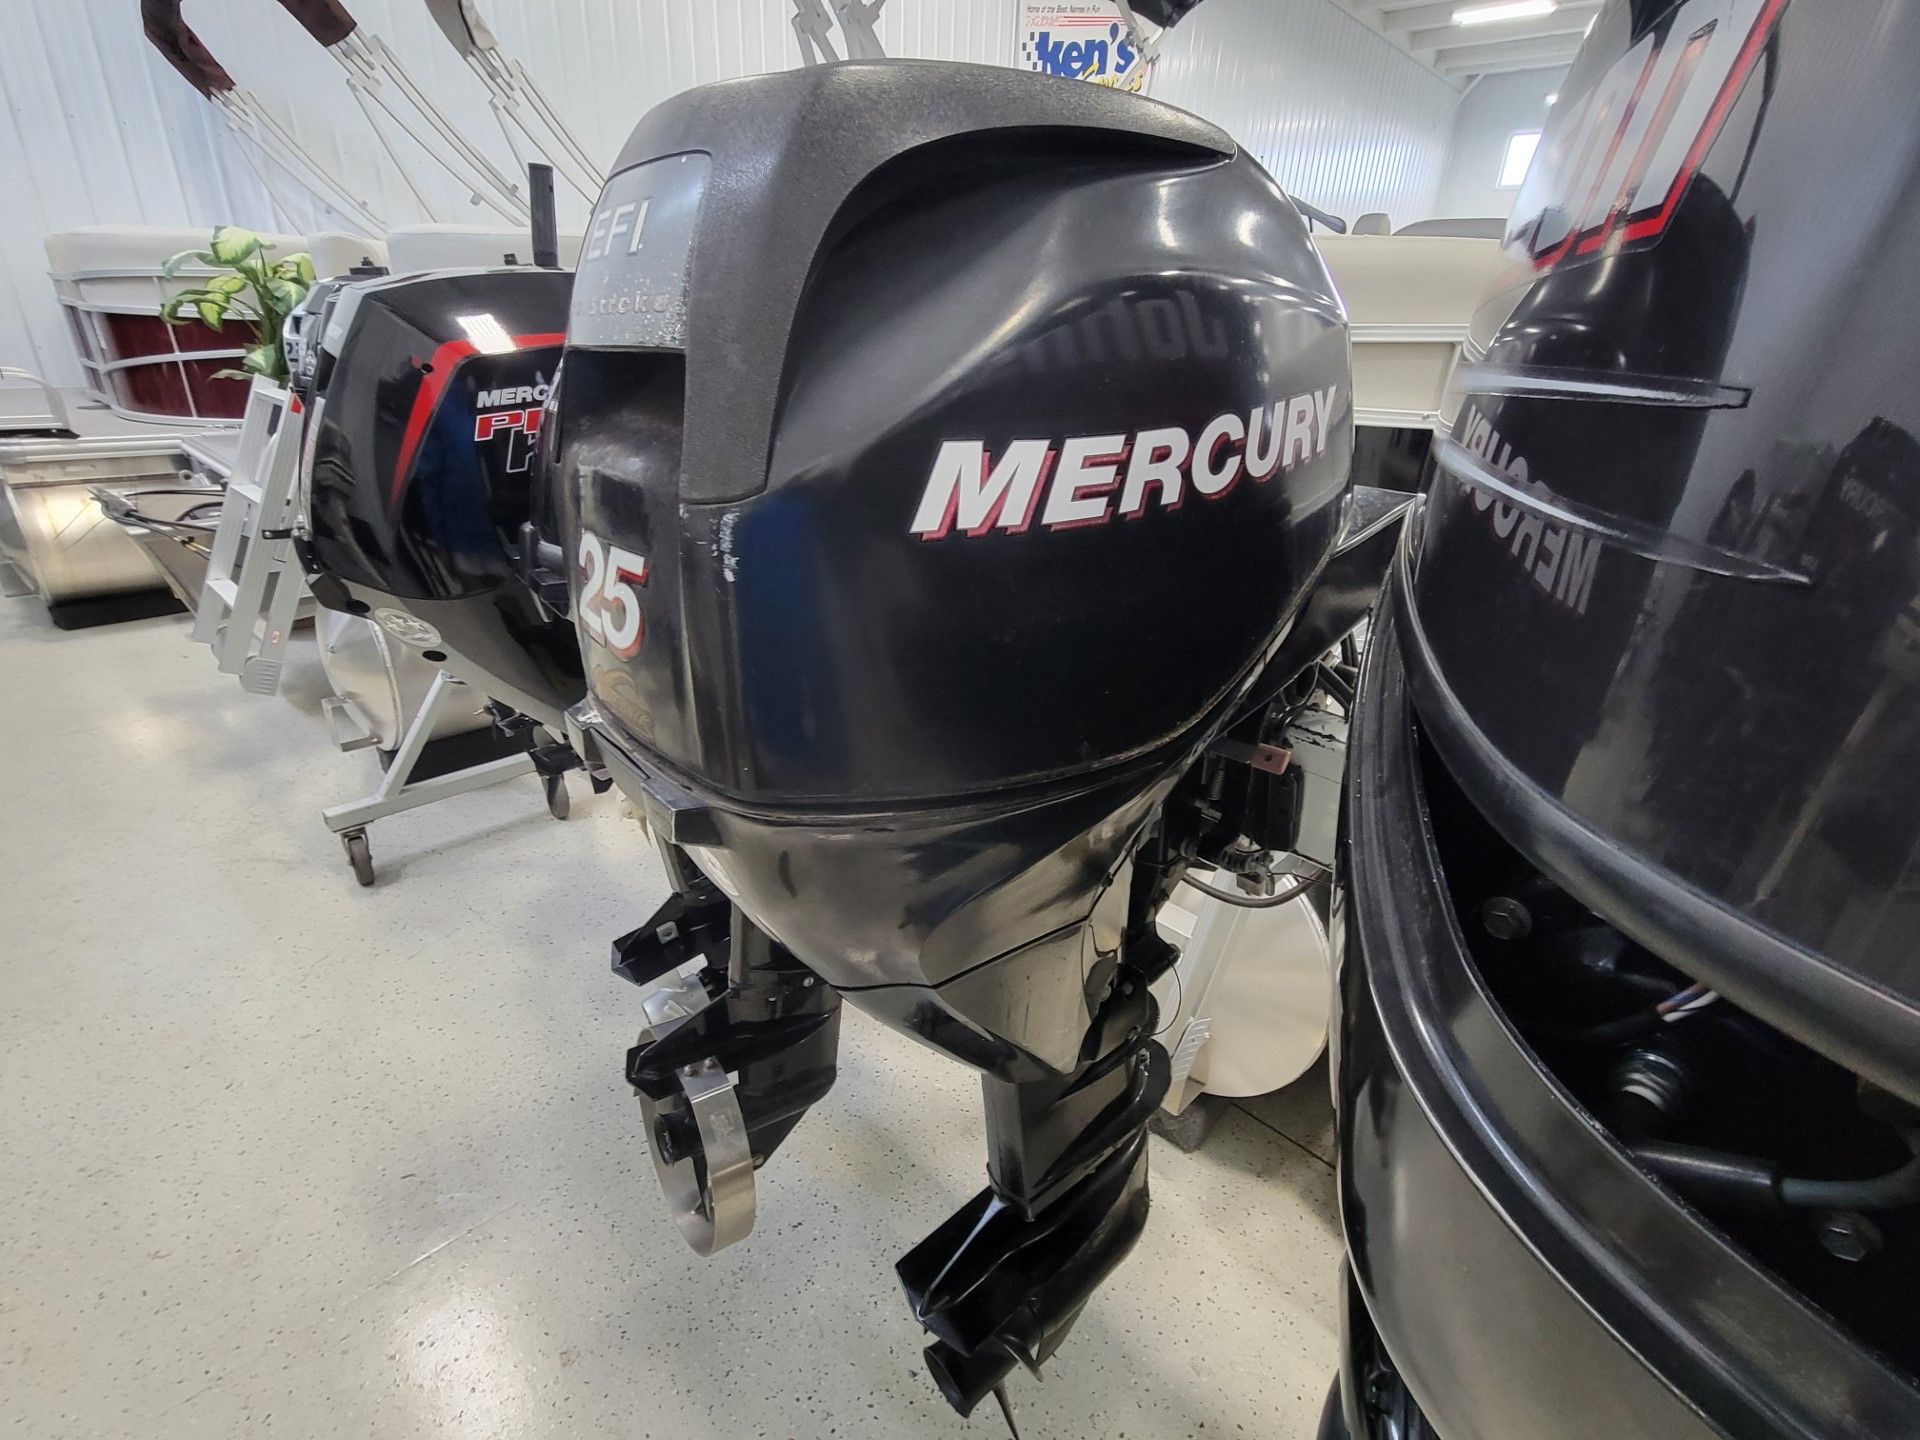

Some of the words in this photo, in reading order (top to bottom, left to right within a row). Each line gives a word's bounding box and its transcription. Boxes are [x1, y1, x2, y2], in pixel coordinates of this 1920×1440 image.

[586, 198, 650, 261] EFI
[908, 385, 1337, 541] MERCURY
[578, 530, 649, 662] 25
